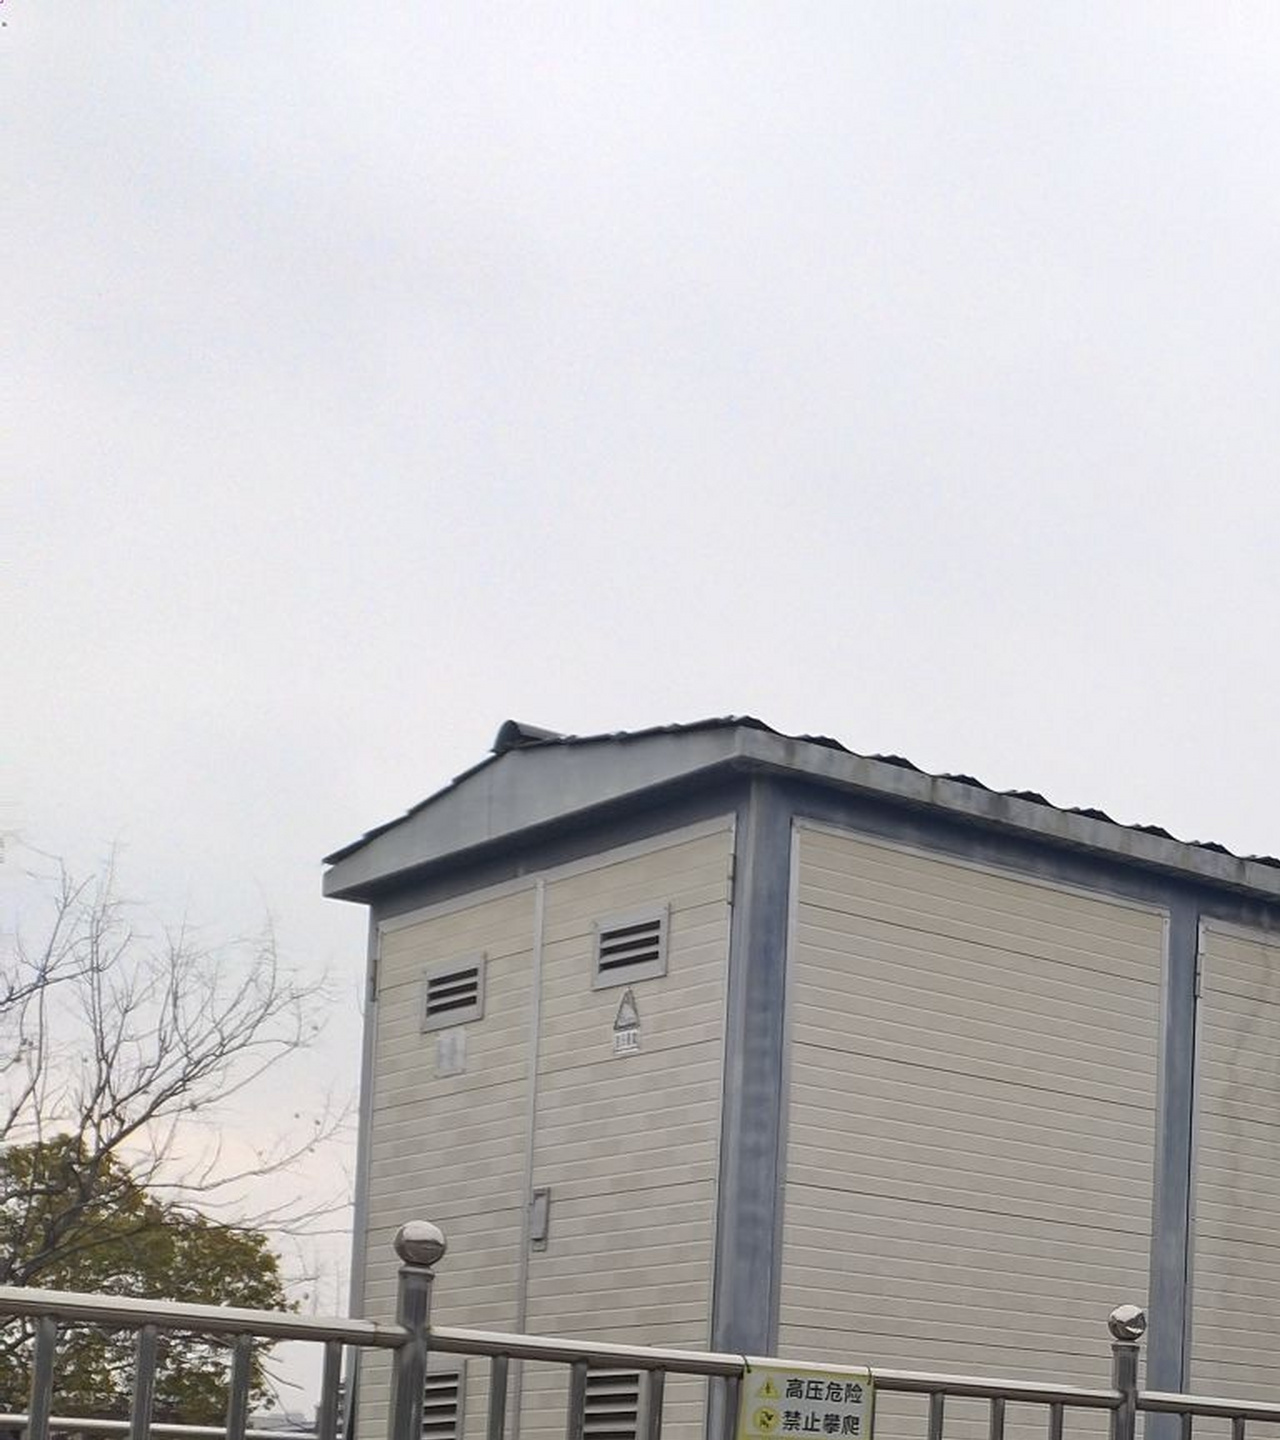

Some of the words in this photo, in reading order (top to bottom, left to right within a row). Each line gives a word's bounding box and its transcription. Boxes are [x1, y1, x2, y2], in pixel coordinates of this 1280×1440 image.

[785, 1378, 863, 1404] 高压危险
[782, 1410, 860, 1436] 禁止攀爬
